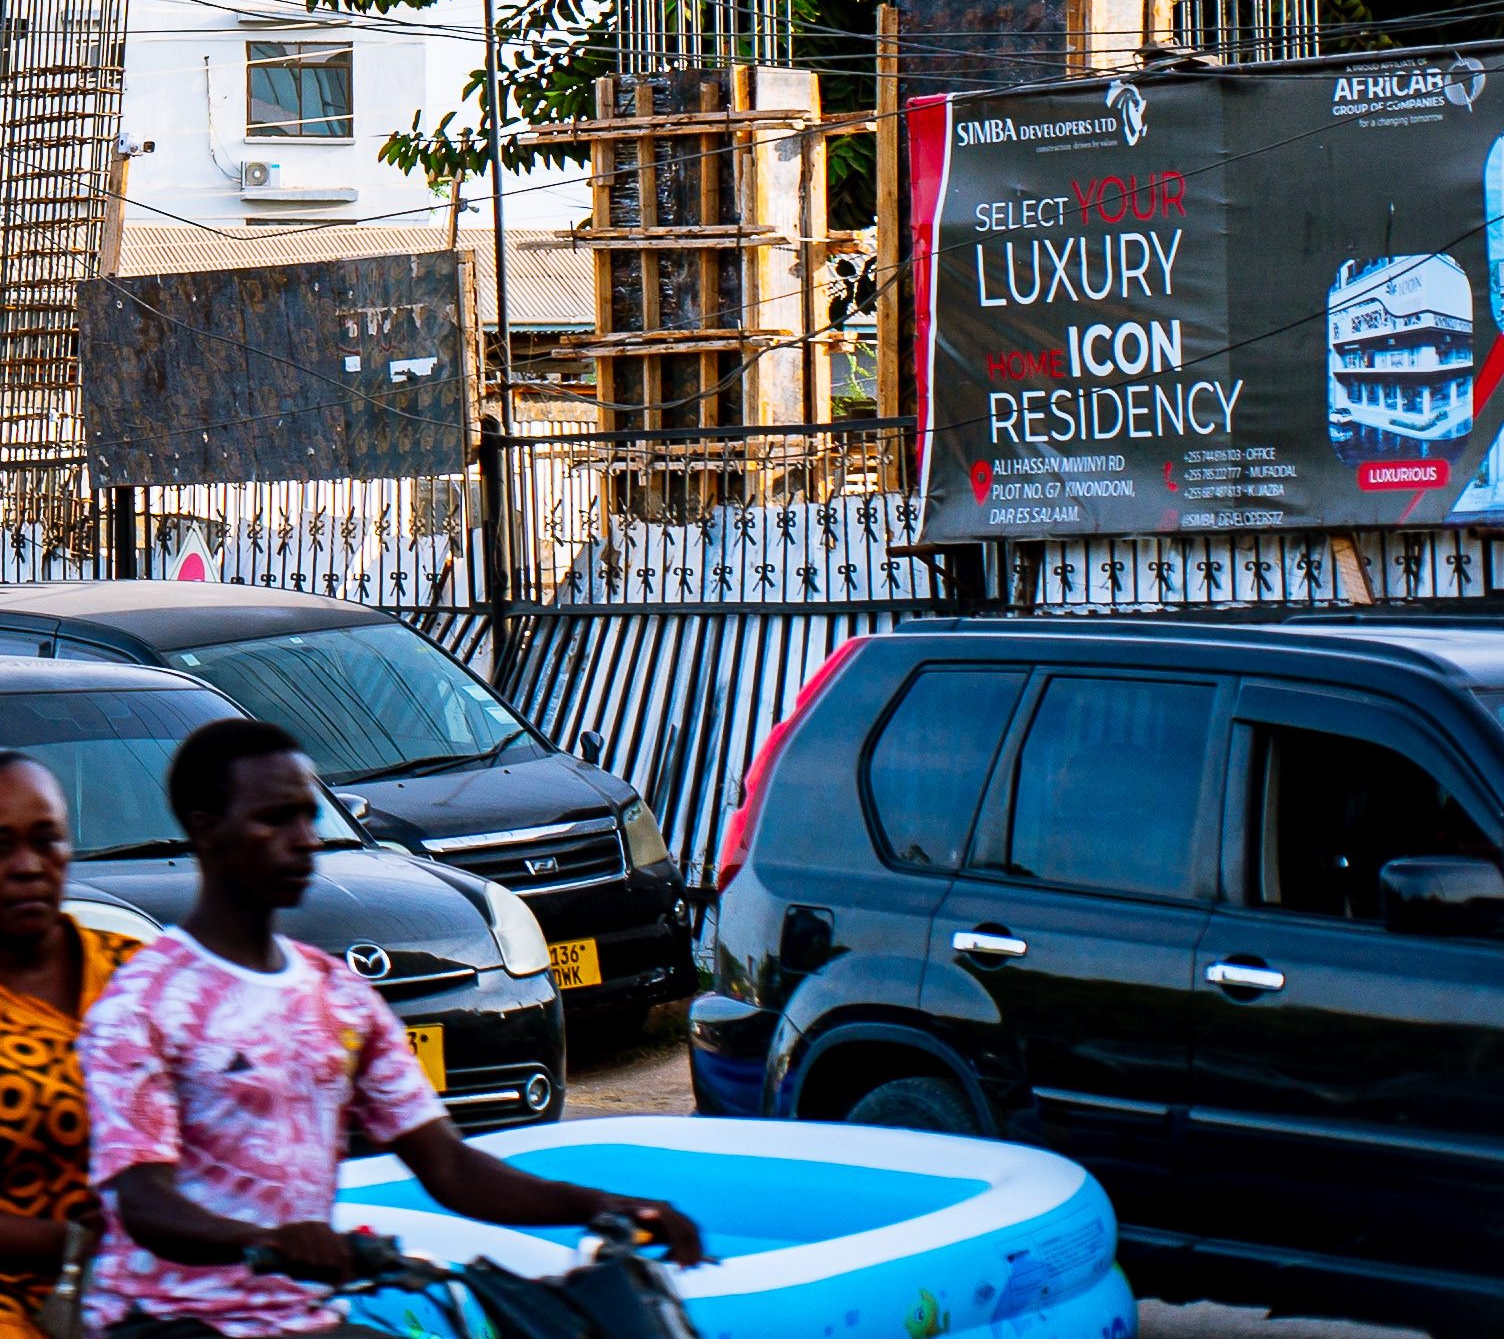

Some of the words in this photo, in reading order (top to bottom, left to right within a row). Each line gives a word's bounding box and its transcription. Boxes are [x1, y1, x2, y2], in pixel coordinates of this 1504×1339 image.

[1333, 101, 1367, 115] GROUP
[1370, 101, 1384, 112] OF
[1386, 96, 1446, 111] COMPANIES
[957, 118, 1018, 147] SIMBA
[1019, 120, 1093, 140] DEVELOPERS
[1094, 118, 1117, 133] LTD
[975, 197, 1068, 232] SELECT
[1071, 171, 1186, 224] YOUR
[976, 228, 1183, 307] LUXURY
[987, 348, 1066, 381] HOME
[1067, 319, 1182, 378] ICON
[989, 379, 1244, 444] RESIDENCY
[1246, 447, 1276, 460] OFFICE
[992, 459, 1011, 475] ALI
[1014, 457, 1060, 474] HASSAN
[1061, 456, 1106, 473] MWINYI
[1109, 455, 1125, 472] RD
[1369, 467, 1437, 483] LUXURIOUS
[992, 483, 1022, 500] PLOT
[989, 508, 1016, 524] DAR
[1016, 507, 1031, 523] ES
